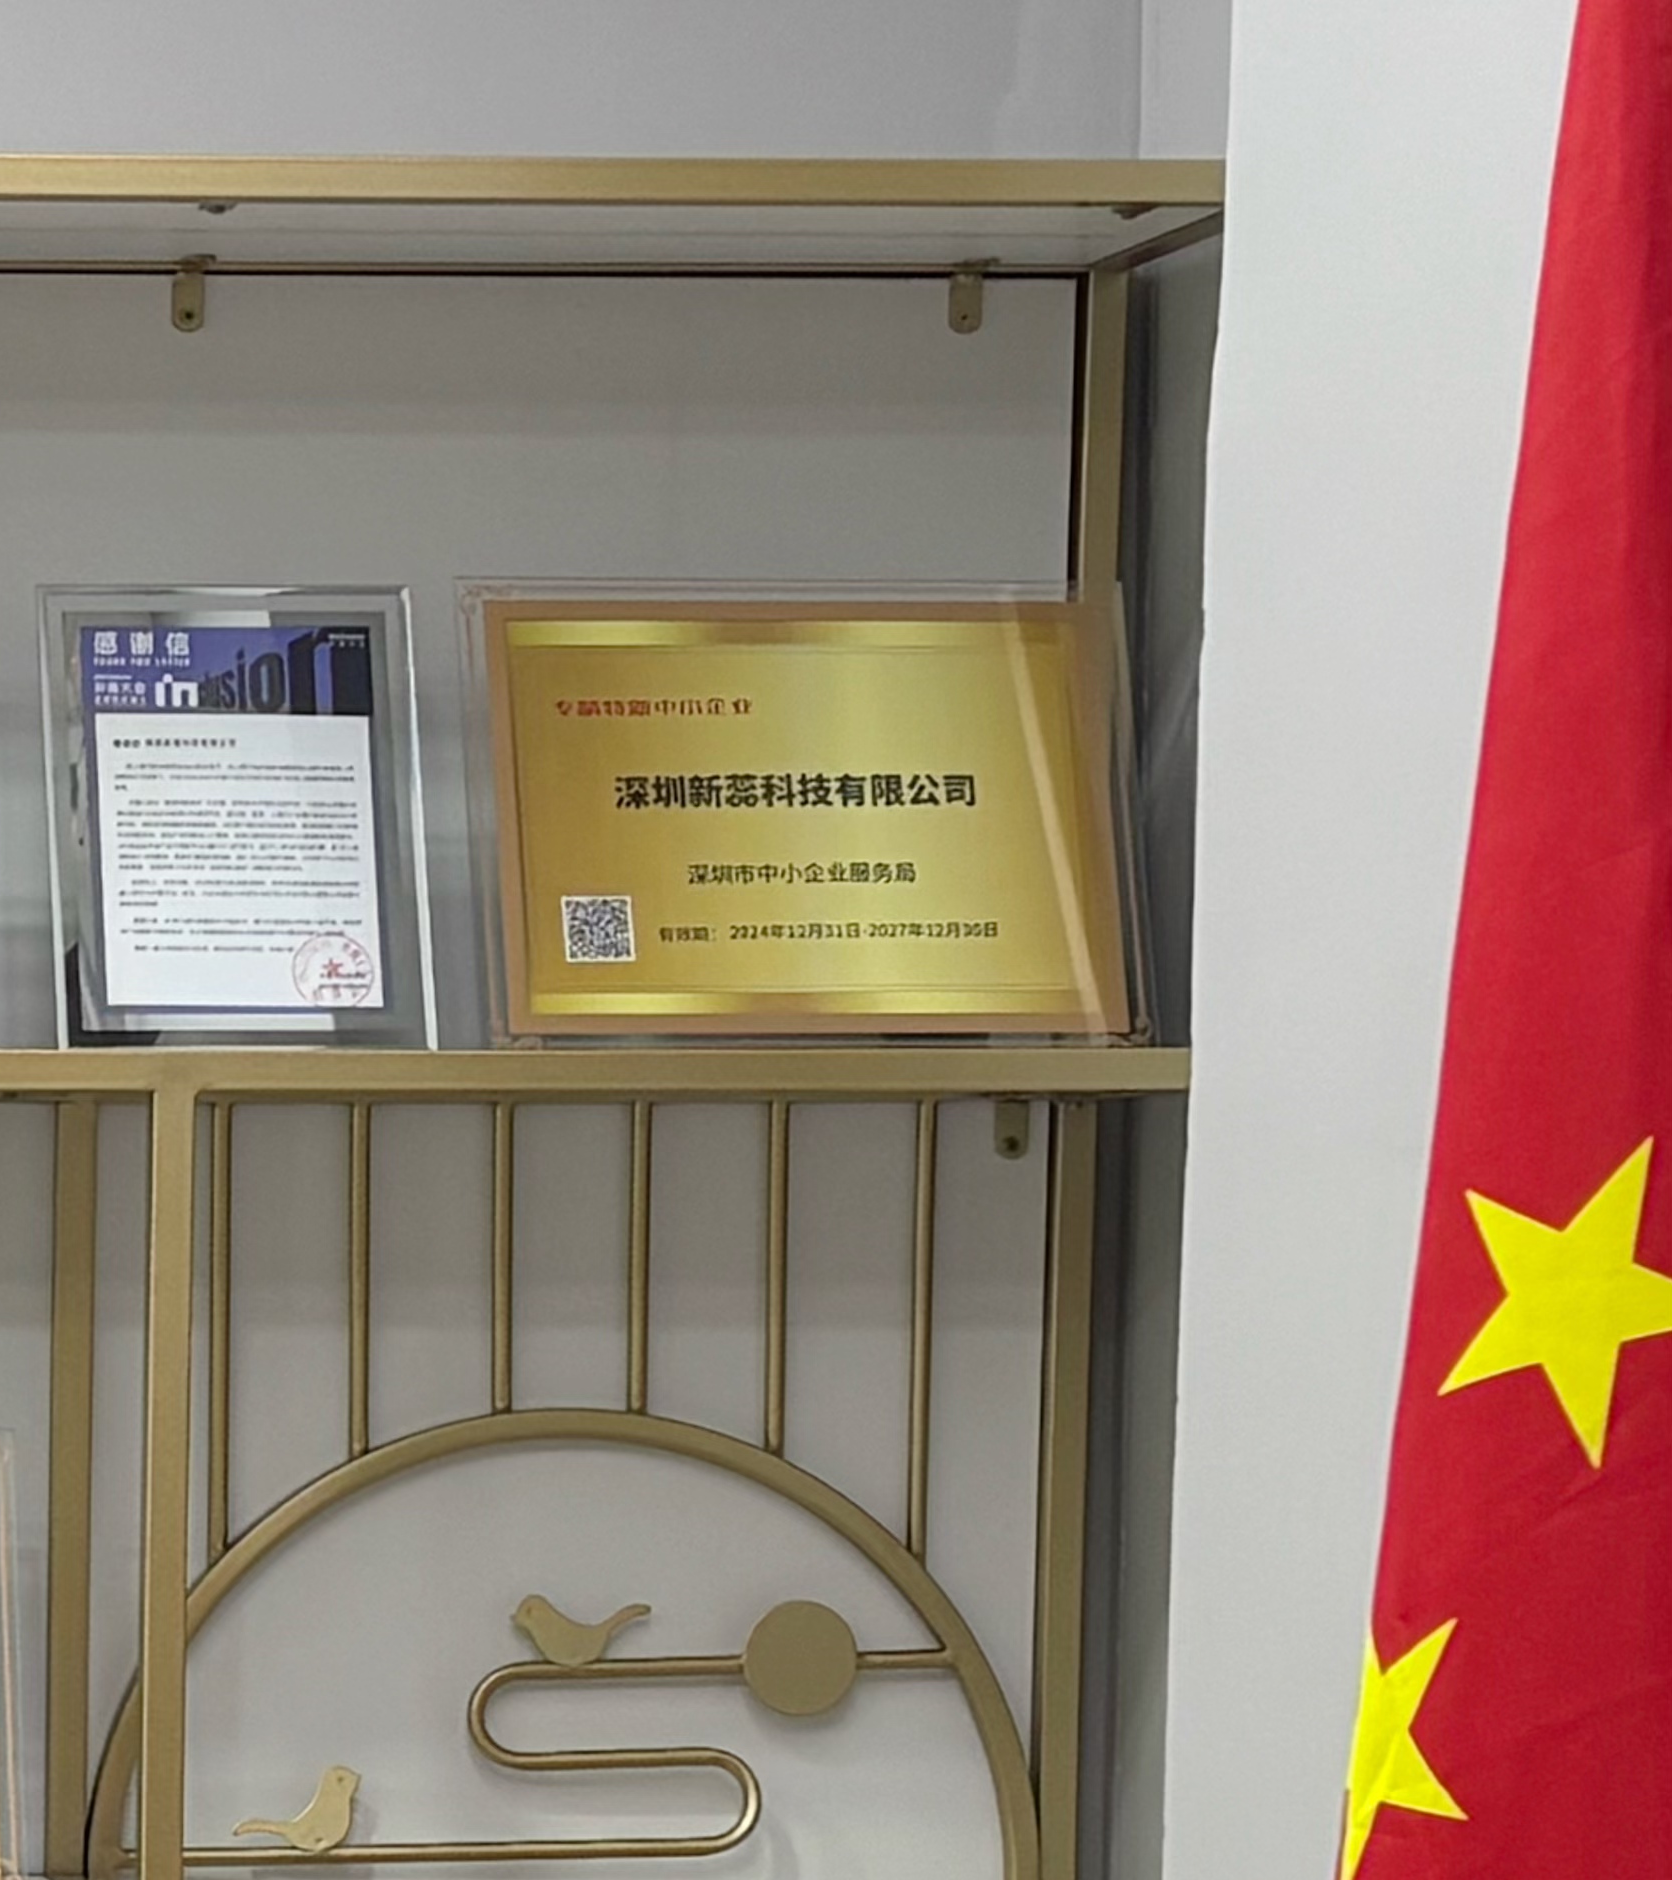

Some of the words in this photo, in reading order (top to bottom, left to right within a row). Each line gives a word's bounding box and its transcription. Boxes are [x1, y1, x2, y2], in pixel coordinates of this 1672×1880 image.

[614, 773, 977, 809] 深圳新蕊科技有限公司
[688, 862, 917, 885] 深圳市中小企业服务局
